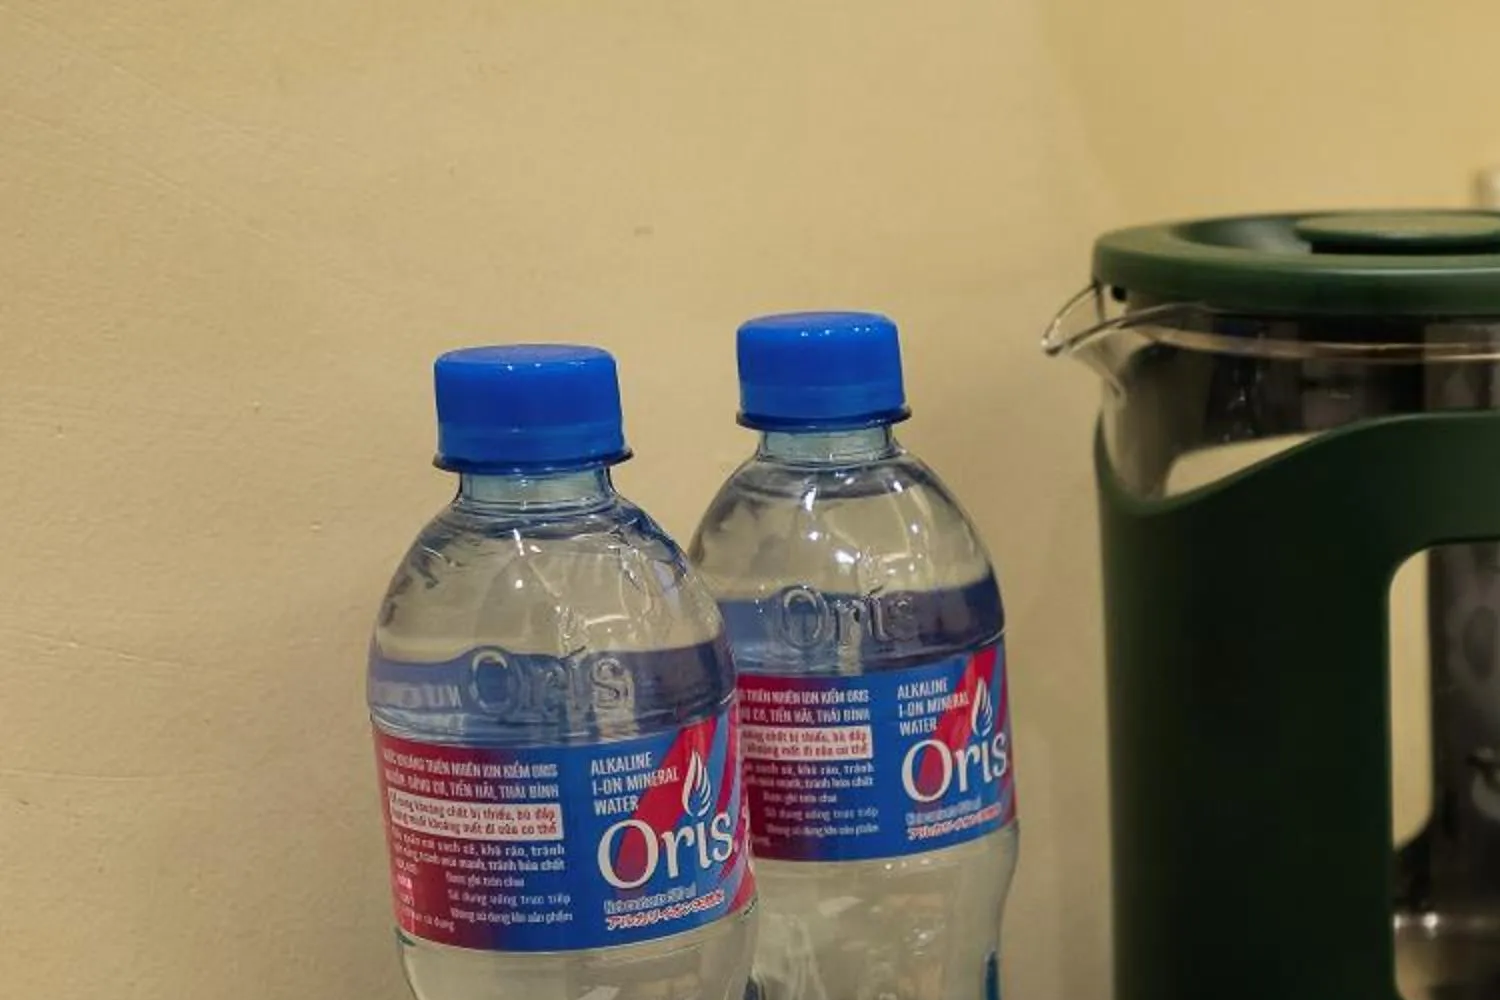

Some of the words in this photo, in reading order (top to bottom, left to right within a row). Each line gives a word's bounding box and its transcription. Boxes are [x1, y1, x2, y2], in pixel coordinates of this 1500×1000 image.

[897, 677, 949, 700] ALKALINE
[899, 702, 925, 719] I-ON
[927, 690, 970, 714] MINERAL
[900, 716, 938, 737] WATER
[590, 751, 652, 775] ALKALINE
[901, 731, 1008, 803] Oris
[592, 777, 622, 796] I-ON
[627, 766, 680, 791] MINERAL
[593, 794, 640, 816] WATER
[597, 811, 733, 890] Oris
